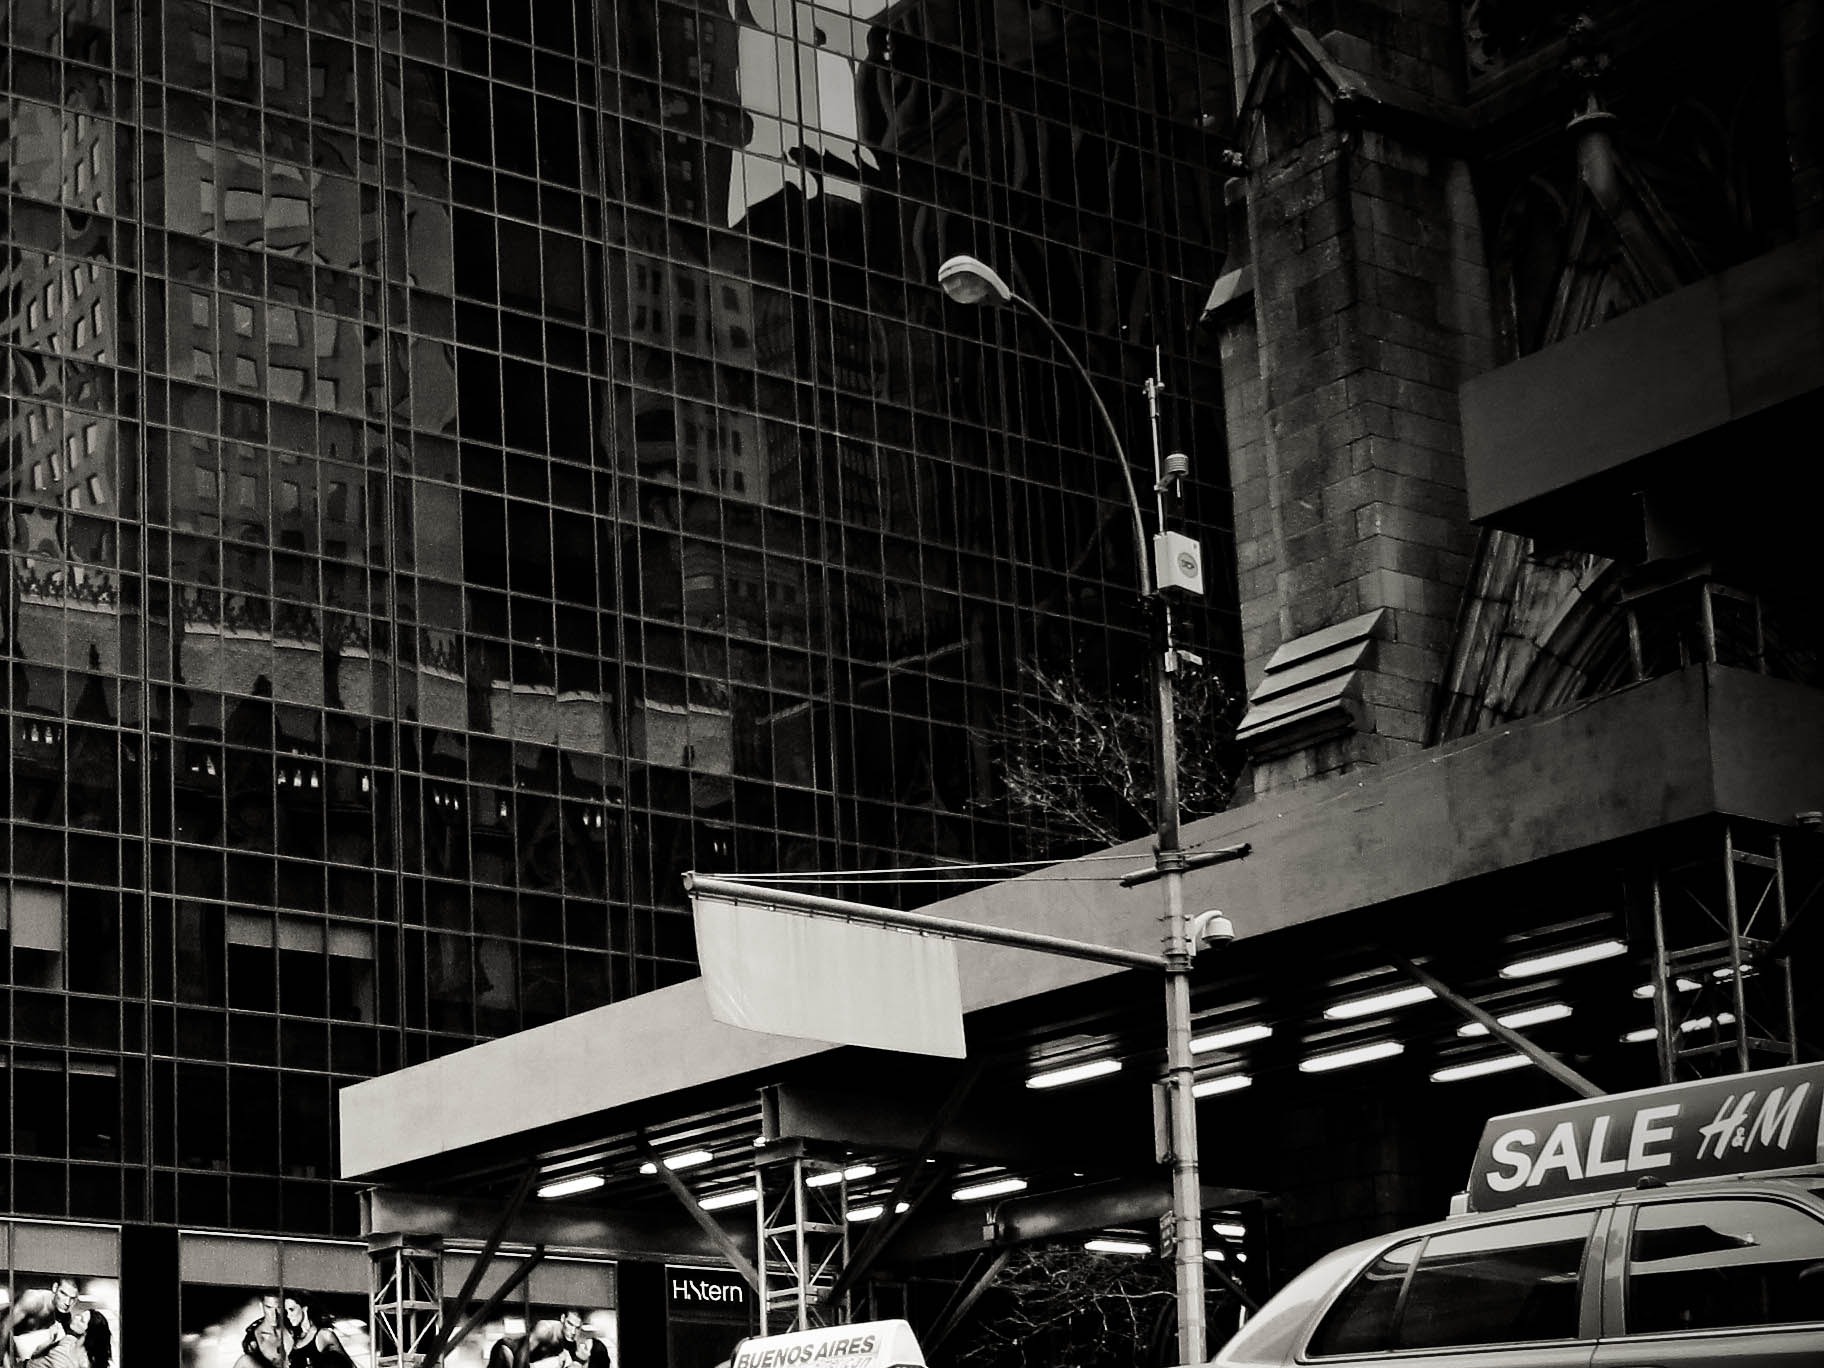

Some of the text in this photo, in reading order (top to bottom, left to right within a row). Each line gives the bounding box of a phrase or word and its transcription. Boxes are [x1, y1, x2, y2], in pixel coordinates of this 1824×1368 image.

[1485, 1081, 1811, 1192] SALE H&M
[815, 1334, 875, 1360] AIRES
